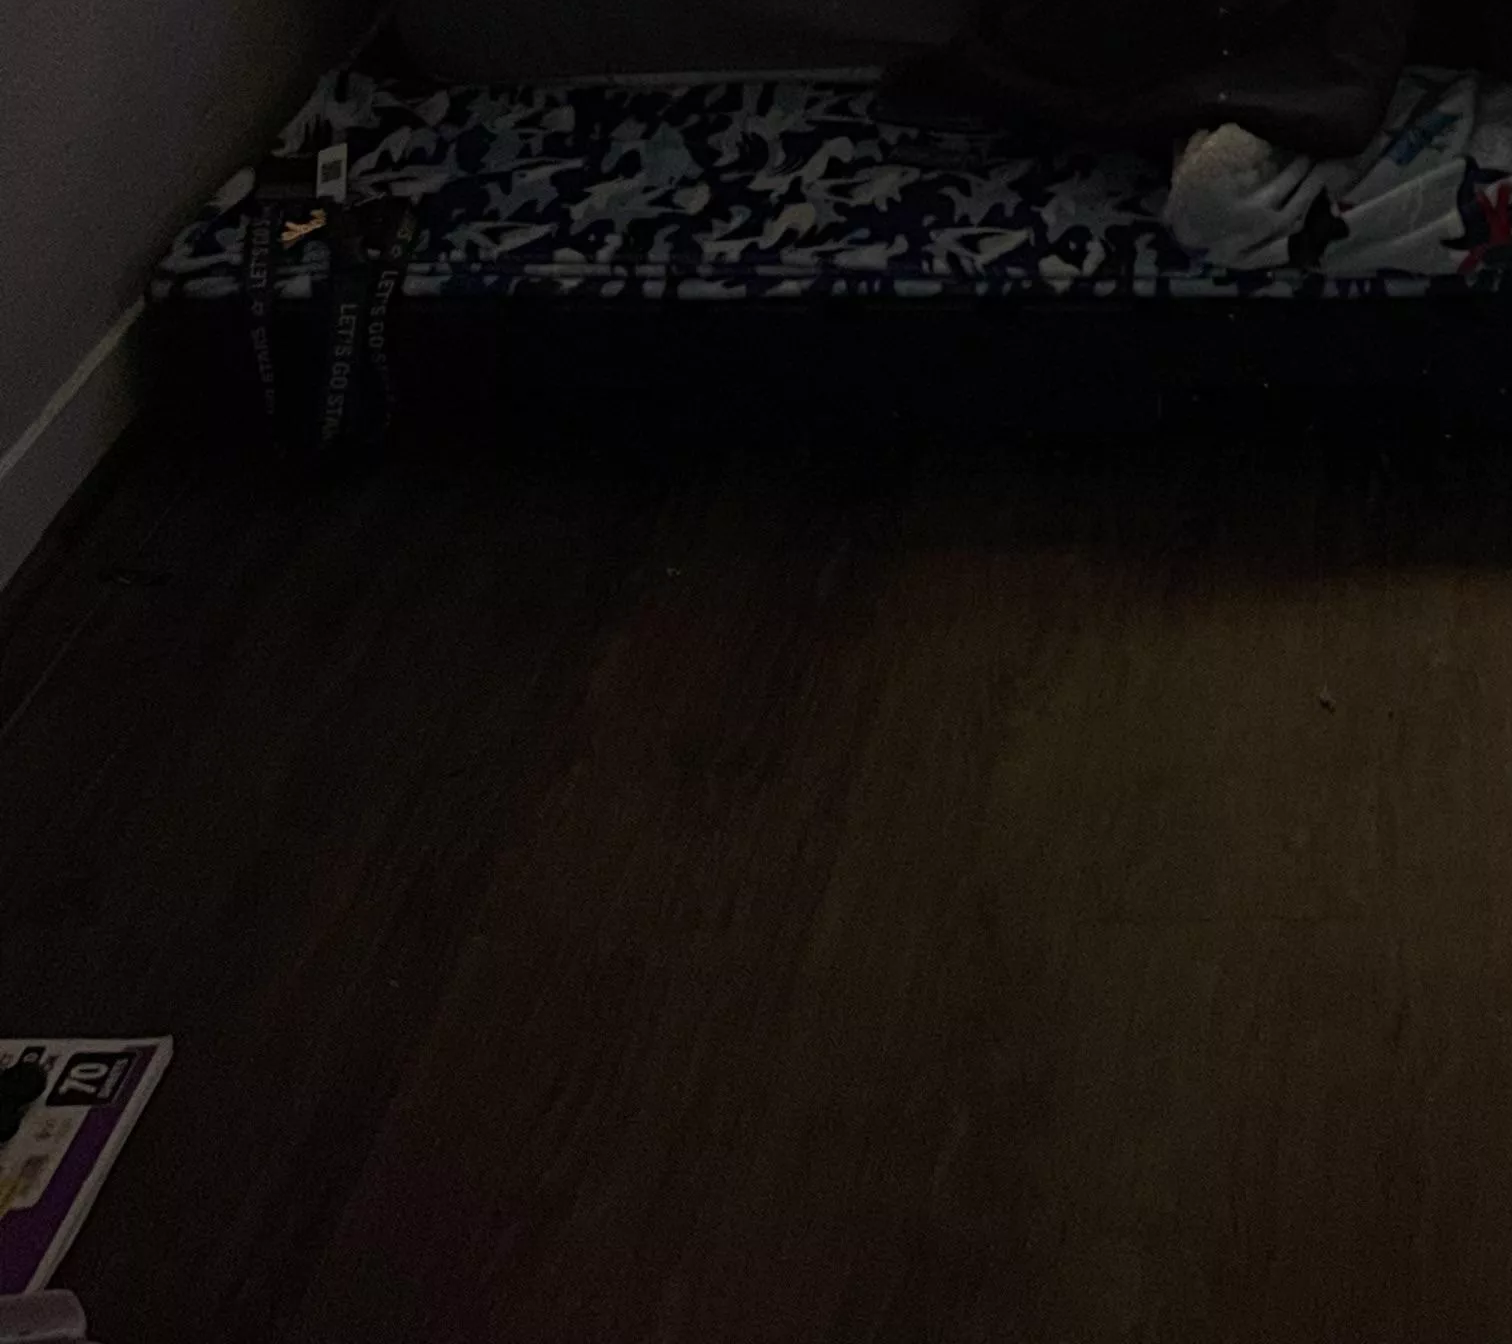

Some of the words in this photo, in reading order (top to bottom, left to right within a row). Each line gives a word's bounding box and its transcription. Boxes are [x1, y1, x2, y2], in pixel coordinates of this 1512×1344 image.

[370, 269, 399, 317] LET'S
[334, 302, 359, 358] LET'S
[329, 362, 351, 390] GO
[57, 1061, 110, 1096] 70
